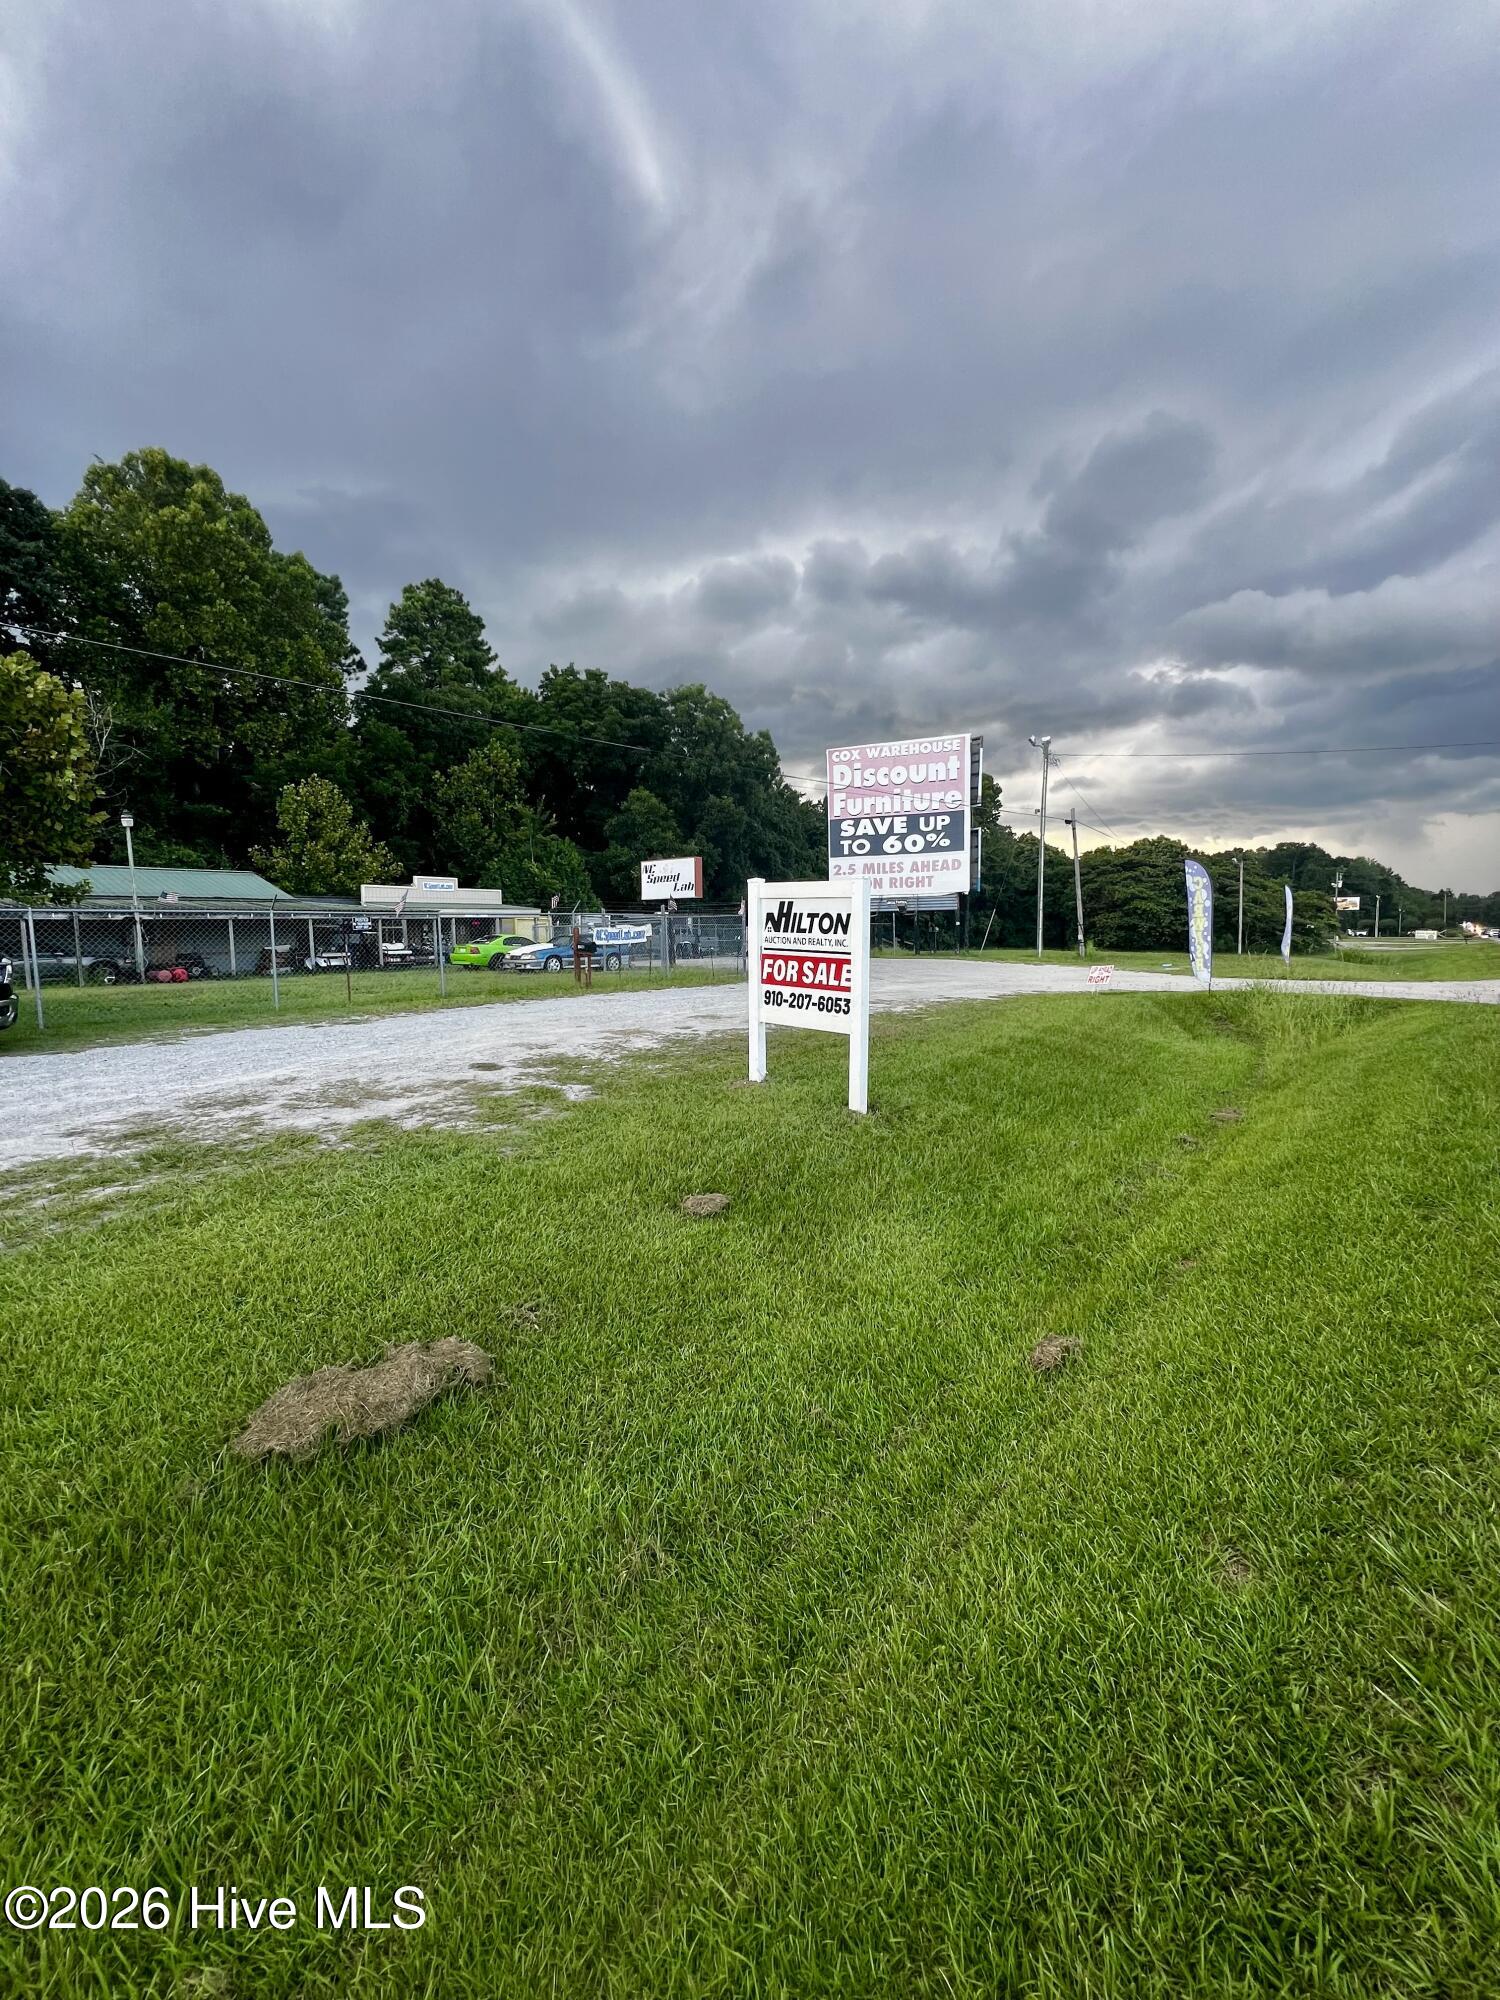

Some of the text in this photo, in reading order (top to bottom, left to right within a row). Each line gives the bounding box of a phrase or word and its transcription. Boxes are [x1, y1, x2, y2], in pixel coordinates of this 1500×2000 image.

[831, 739, 961, 762] COX WAREHOUSE
[832, 755, 960, 790] Discount
[833, 789, 962, 817] Furniture
[840, 815, 951, 837] SAVE UP
[840, 832, 951, 855] TO 60%
[646, 873, 680, 884] Speed
[833, 859, 962, 876] 2.5 MILES AHEAD
[673, 882, 694, 892] Lab
[889, 875, 934, 889] RIGHT
[765, 901, 851, 935] HILTON
[764, 936, 849, 948] AUCTION AND REALTY, INC.
[762, 958, 851, 987] FOR SALE
[764, 990, 851, 1015] 910-207-6053
